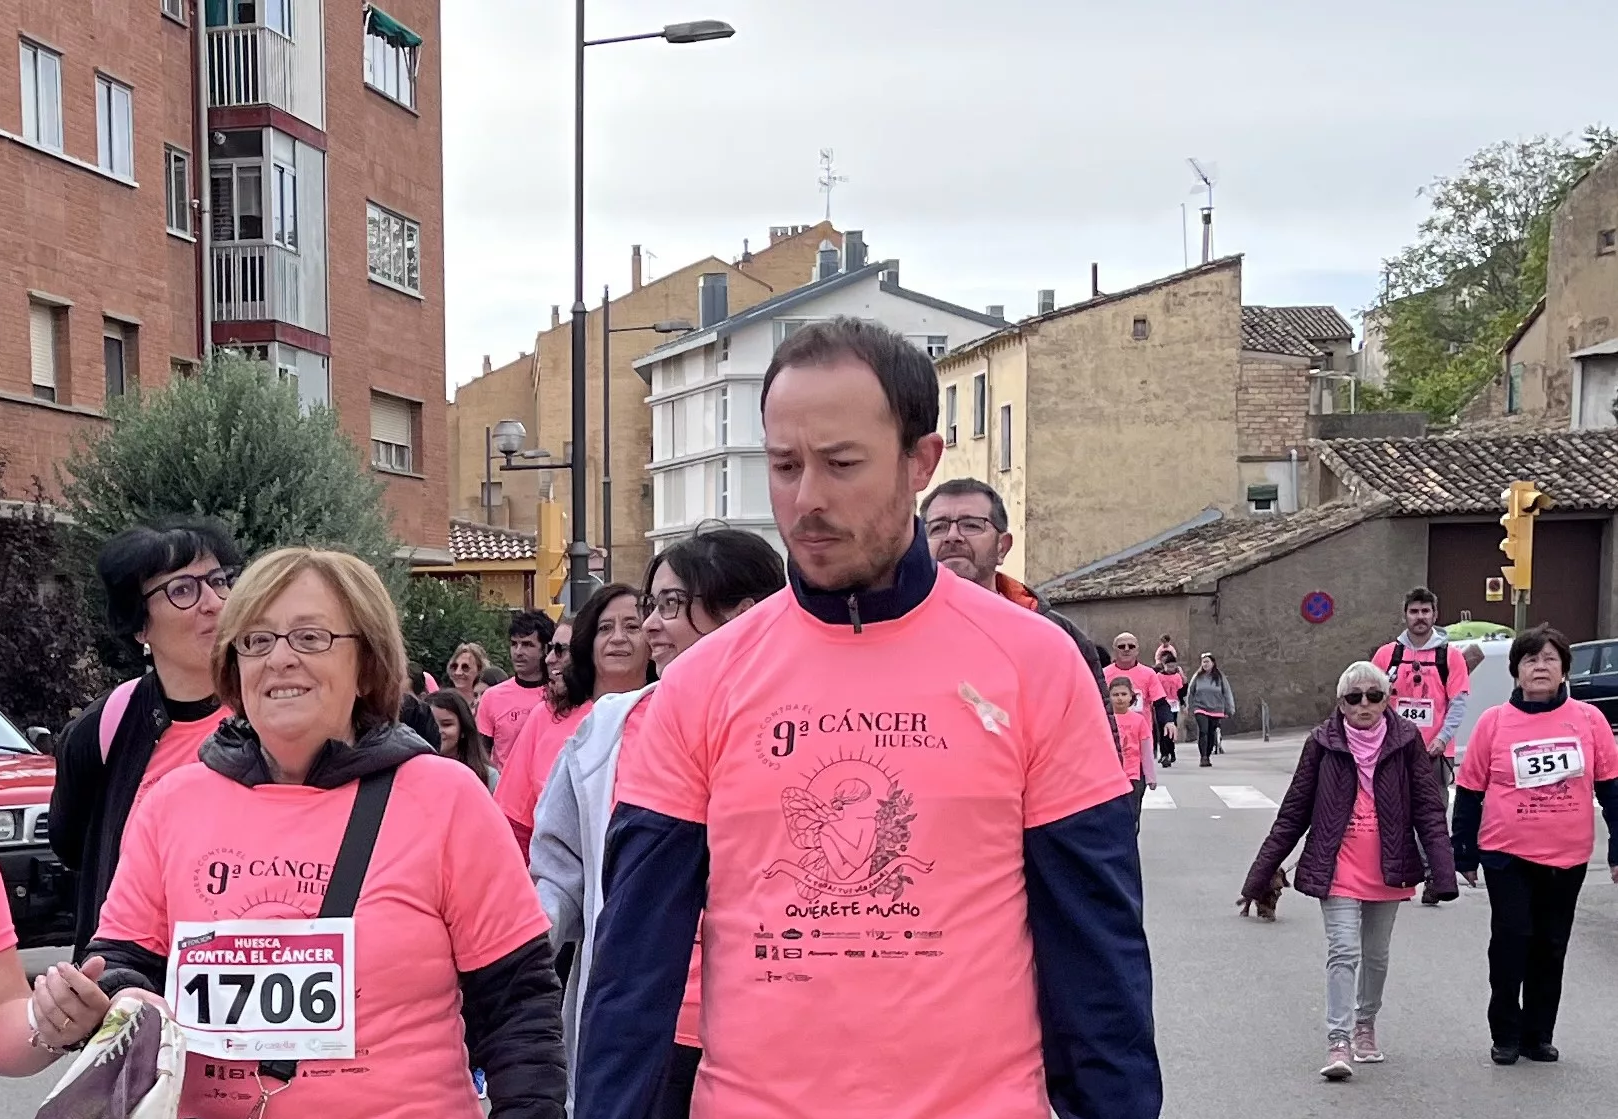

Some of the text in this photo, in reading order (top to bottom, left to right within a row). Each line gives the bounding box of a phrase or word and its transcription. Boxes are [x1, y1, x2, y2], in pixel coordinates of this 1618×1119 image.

[818, 708, 928, 733] CÁNCER
[1401, 708, 1426, 720] 484
[874, 734, 949, 750] HUESCA
[1527, 753, 1569, 775] 351
[249, 856, 334, 882] CÁNCE
[785, 900, 920, 922] QUIÉRETE MUCHO
[234, 938, 281, 949] HUESCA
[186, 946, 335, 964] CONTRA EL CÁNCER
[184, 971, 337, 1025] 1706
